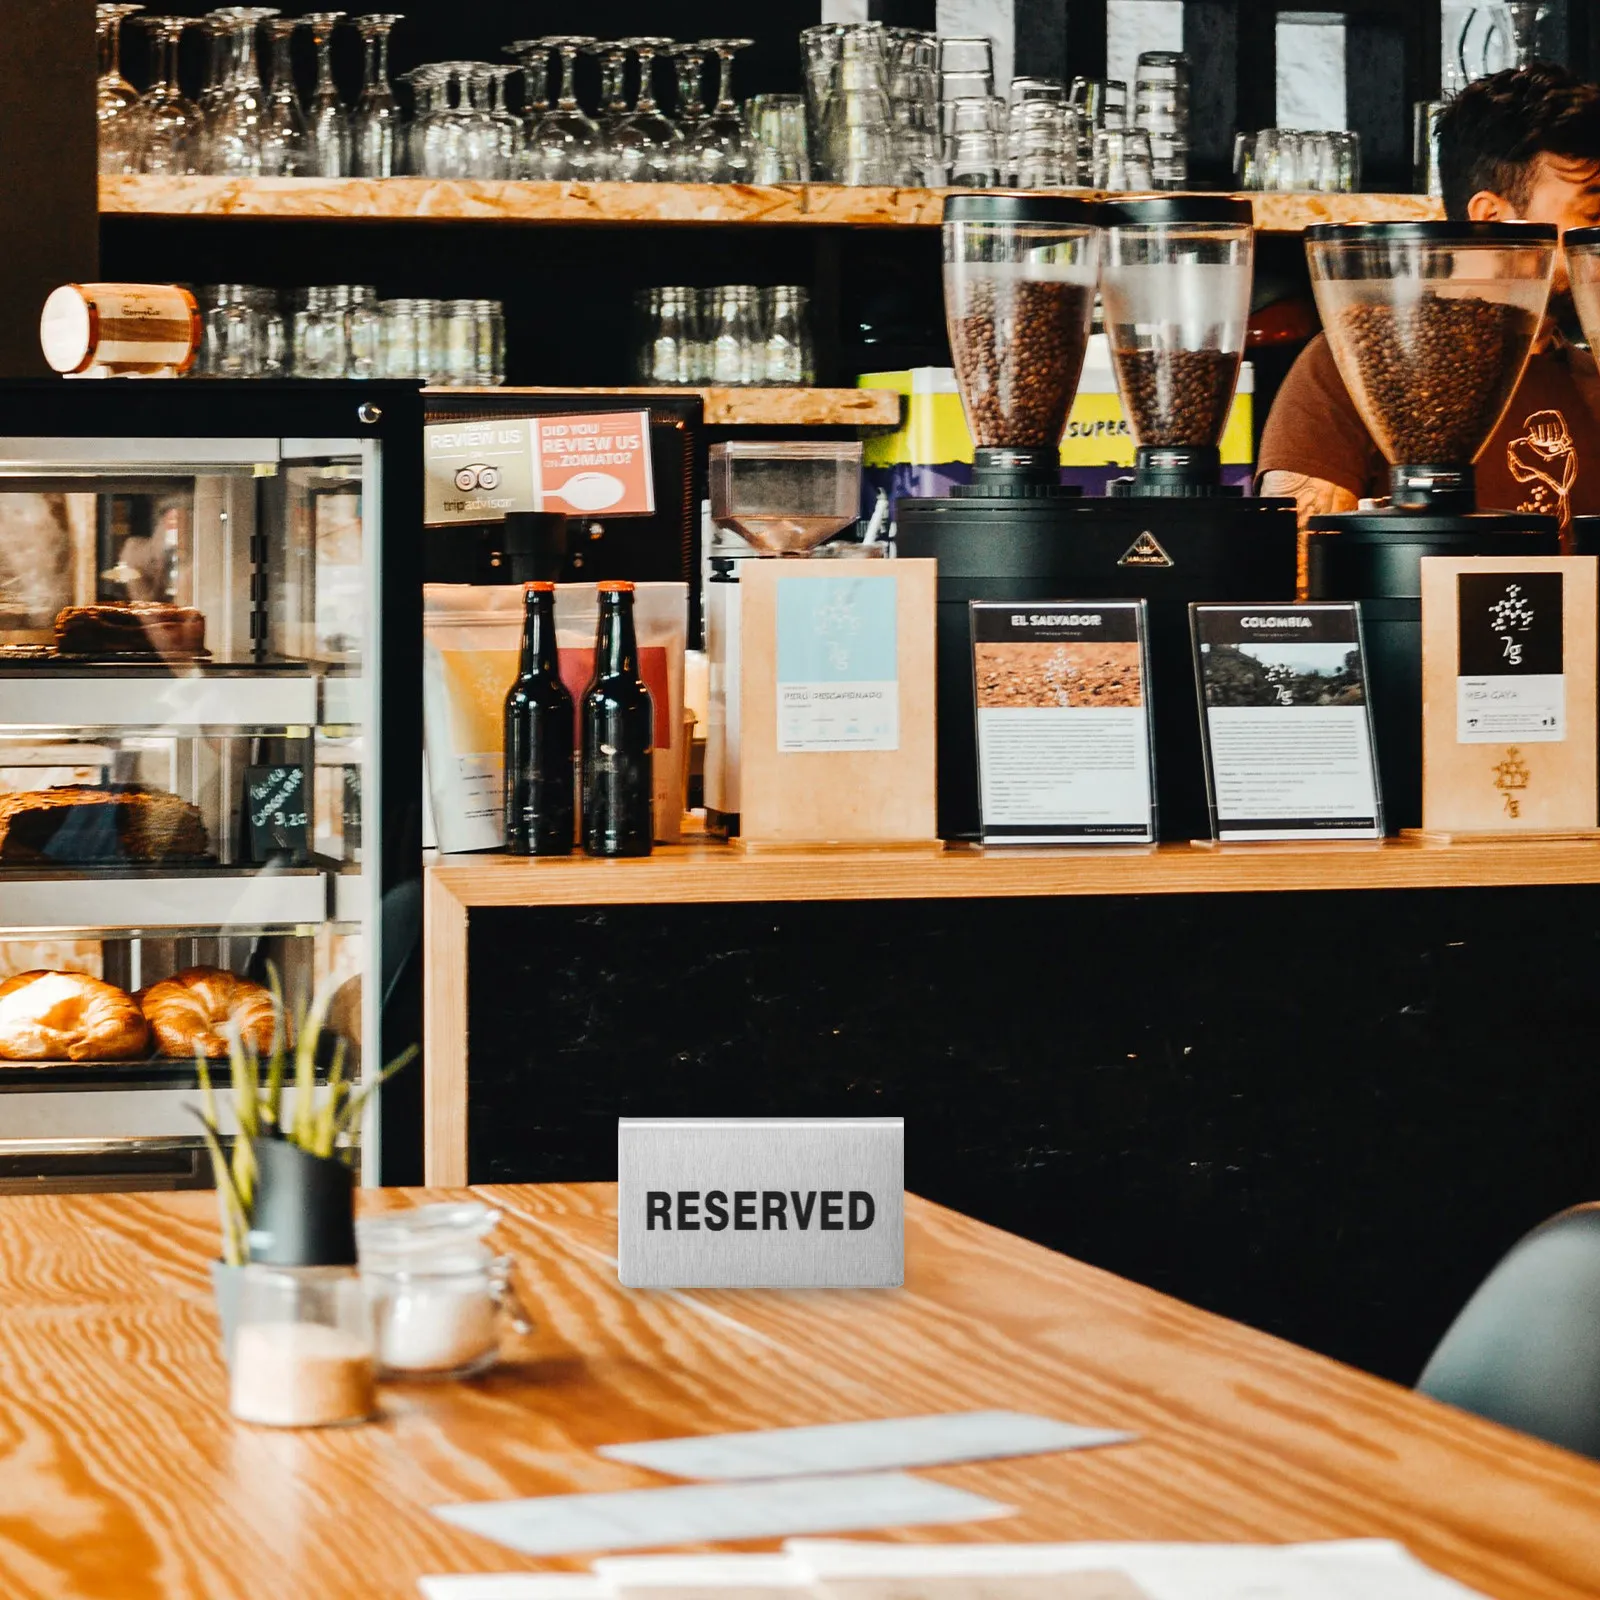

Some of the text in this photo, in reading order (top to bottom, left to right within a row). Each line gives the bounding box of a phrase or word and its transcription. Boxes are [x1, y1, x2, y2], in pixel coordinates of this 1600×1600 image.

[542, 423, 600, 436] DID YOU
[1068, 420, 1131, 438] SUPER
[430, 430, 522, 449] REVIEW US
[542, 434, 640, 453] REVIEW US
[560, 452, 633, 467] ZOMATO?
[1011, 614, 1102, 626] EL SALVADOR
[1240, 616, 1313, 628] COLOMBIA
[646, 1190, 876, 1232] RESERVED
